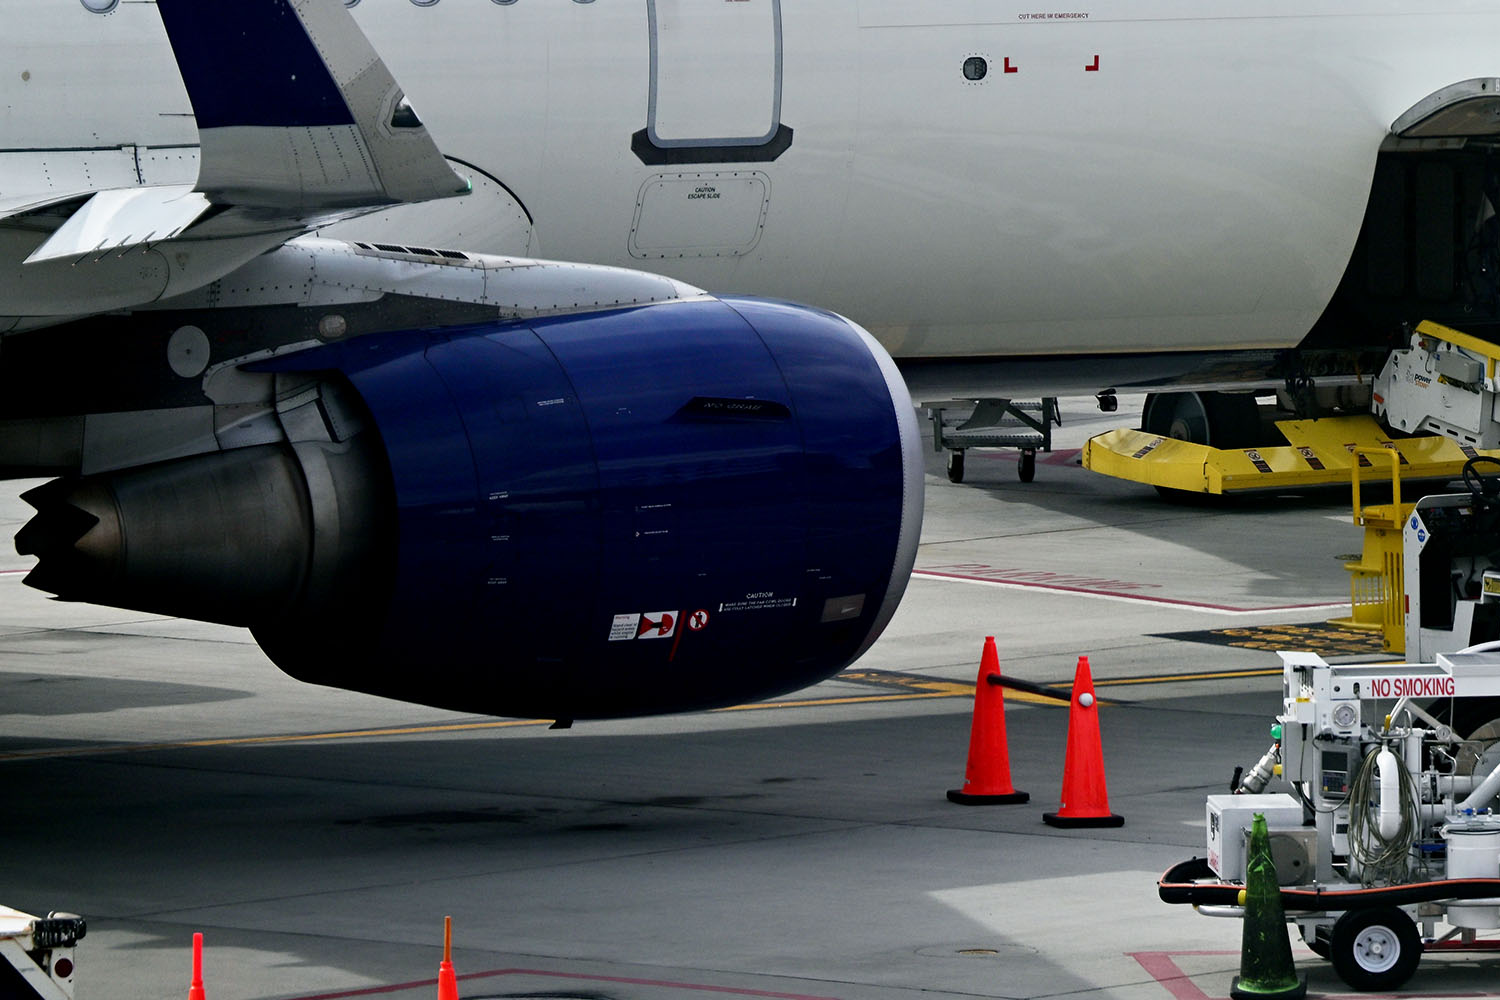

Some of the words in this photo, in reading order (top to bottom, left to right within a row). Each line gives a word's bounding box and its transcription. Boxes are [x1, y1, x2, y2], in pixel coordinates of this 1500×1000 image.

[1414, 373, 1431, 384] power
[1371, 679, 1391, 697] NO
[1393, 677, 1455, 696] SMOKING
